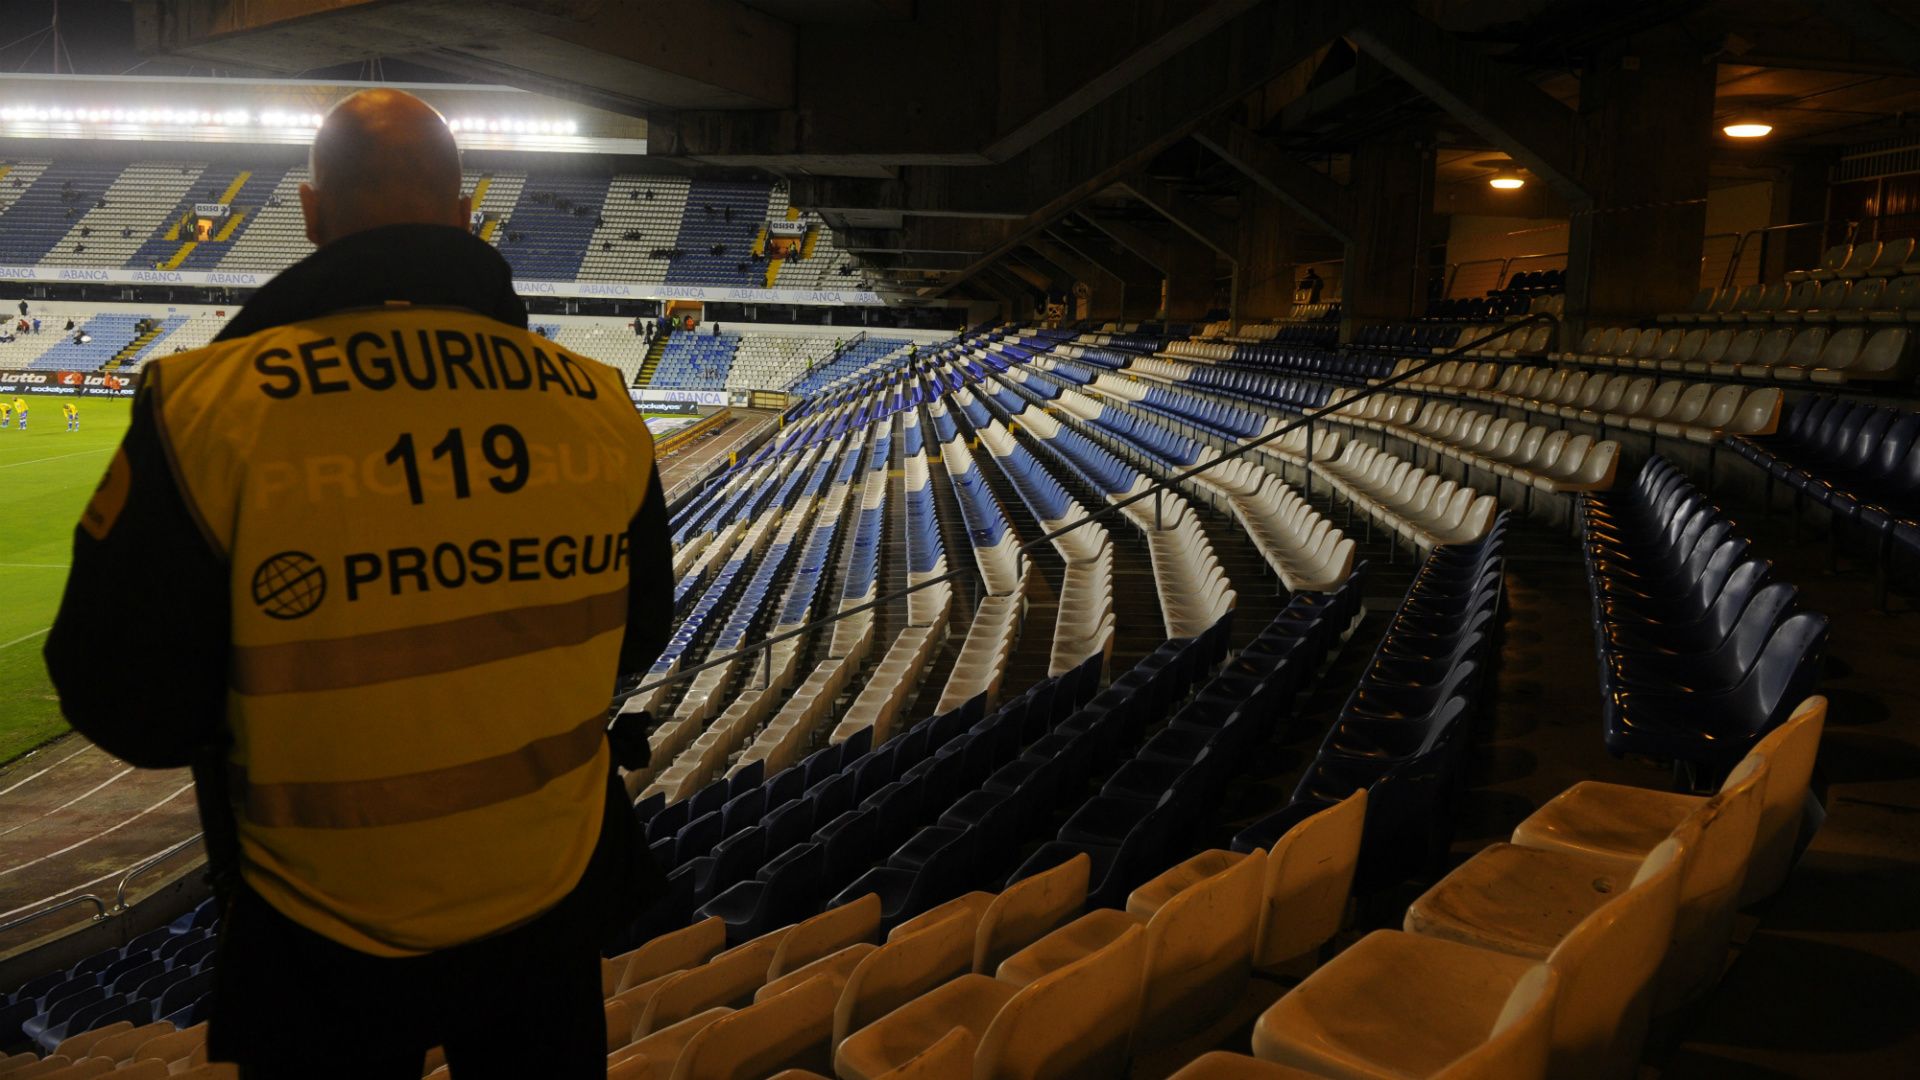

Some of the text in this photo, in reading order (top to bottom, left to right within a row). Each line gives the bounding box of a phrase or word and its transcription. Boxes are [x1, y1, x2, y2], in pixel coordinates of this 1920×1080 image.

[62, 271, 109, 280] ABANCA
[135, 272, 183, 282] ABANCA
[209, 275, 256, 284] ABANCA
[515, 283, 555, 294] BANCA
[583, 285, 630, 295] ABANCA
[658, 287, 705, 298] ABANCA
[254, 329, 598, 400] SEGURIDAD
[668, 391, 721, 404] ABANCA
[385, 423, 531, 505] 119
[344, 532, 631, 602] PROSEGUR
